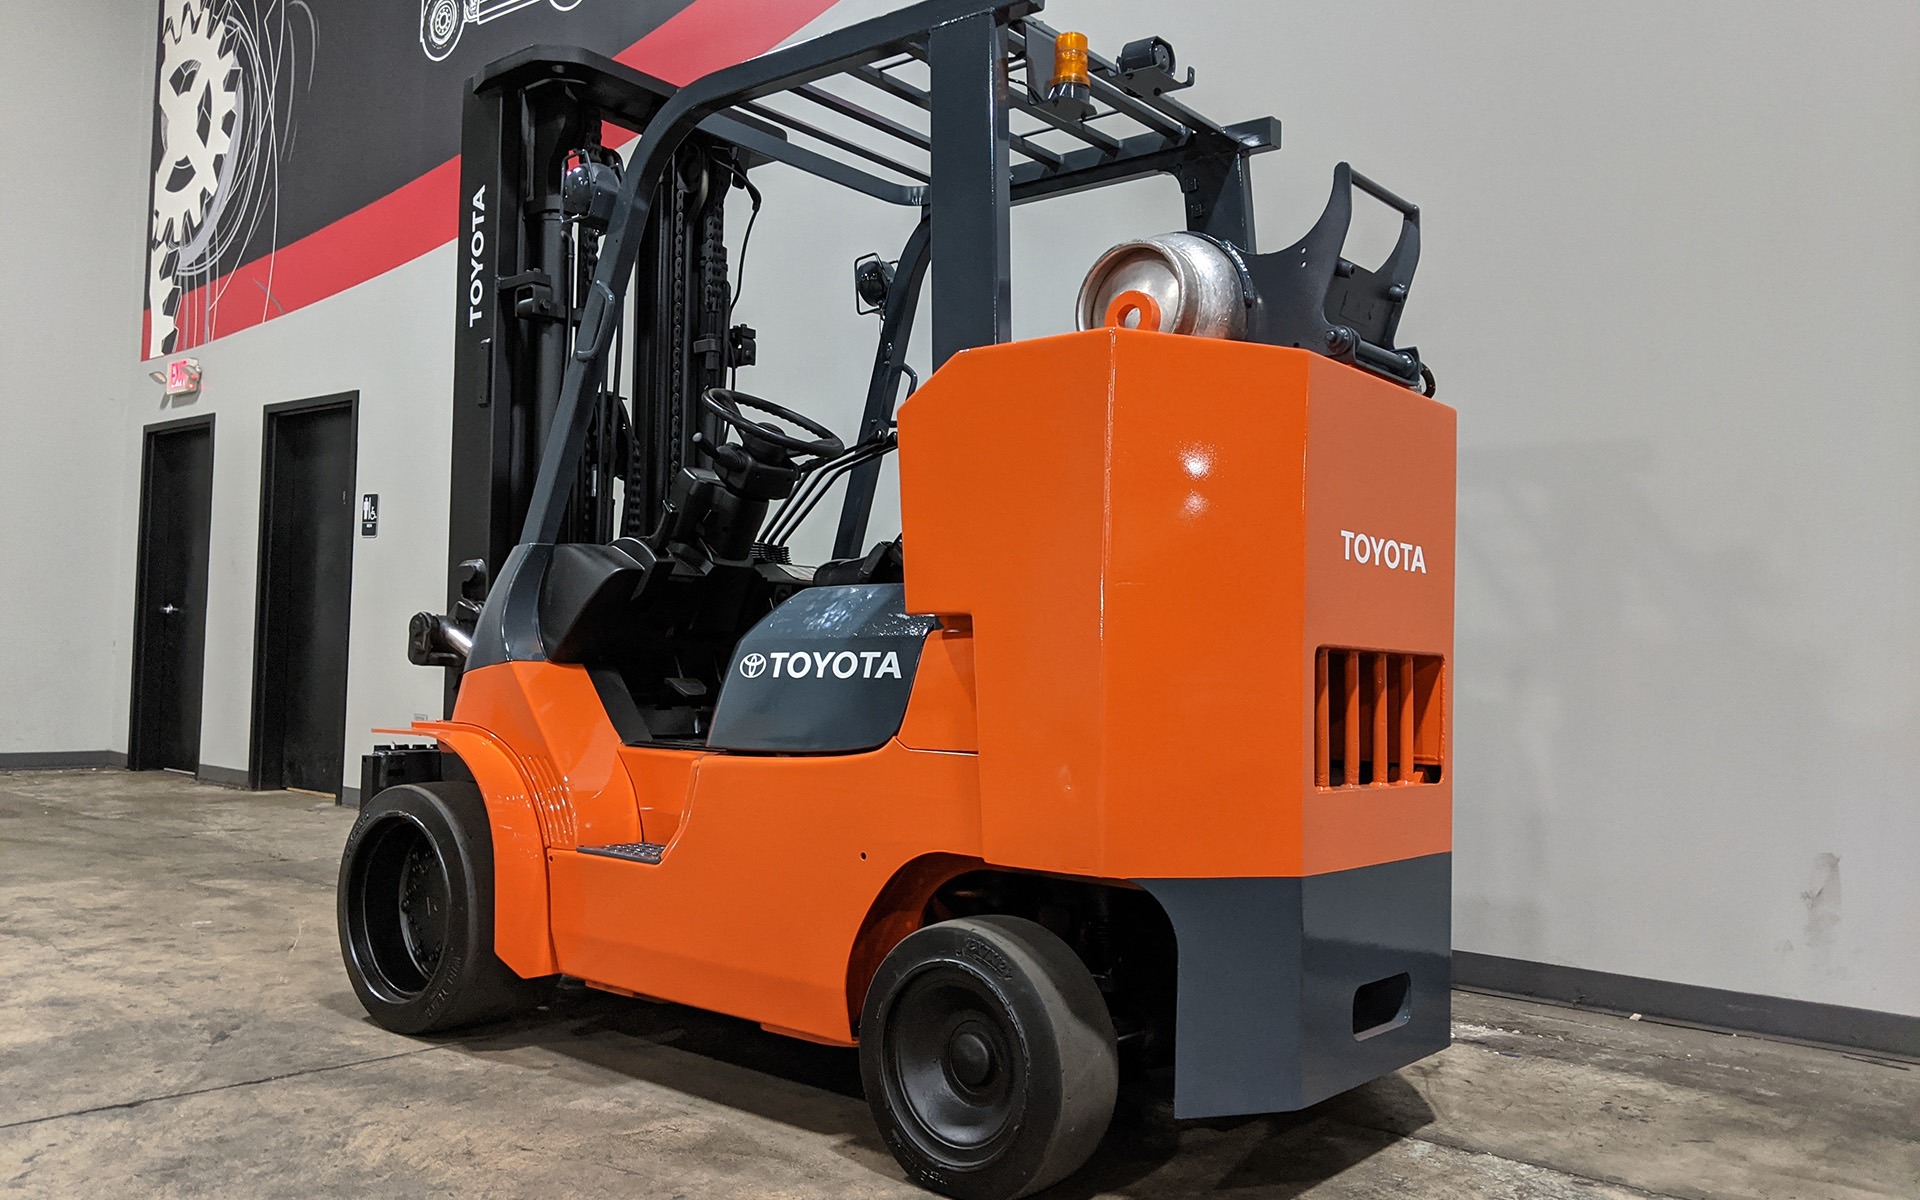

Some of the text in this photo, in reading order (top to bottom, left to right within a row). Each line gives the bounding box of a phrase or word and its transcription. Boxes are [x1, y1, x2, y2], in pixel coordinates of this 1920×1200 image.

[469, 184, 486, 328] TOYOTA
[1340, 529, 1427, 574] TOYOTA
[770, 650, 902, 679] TOYOTA
